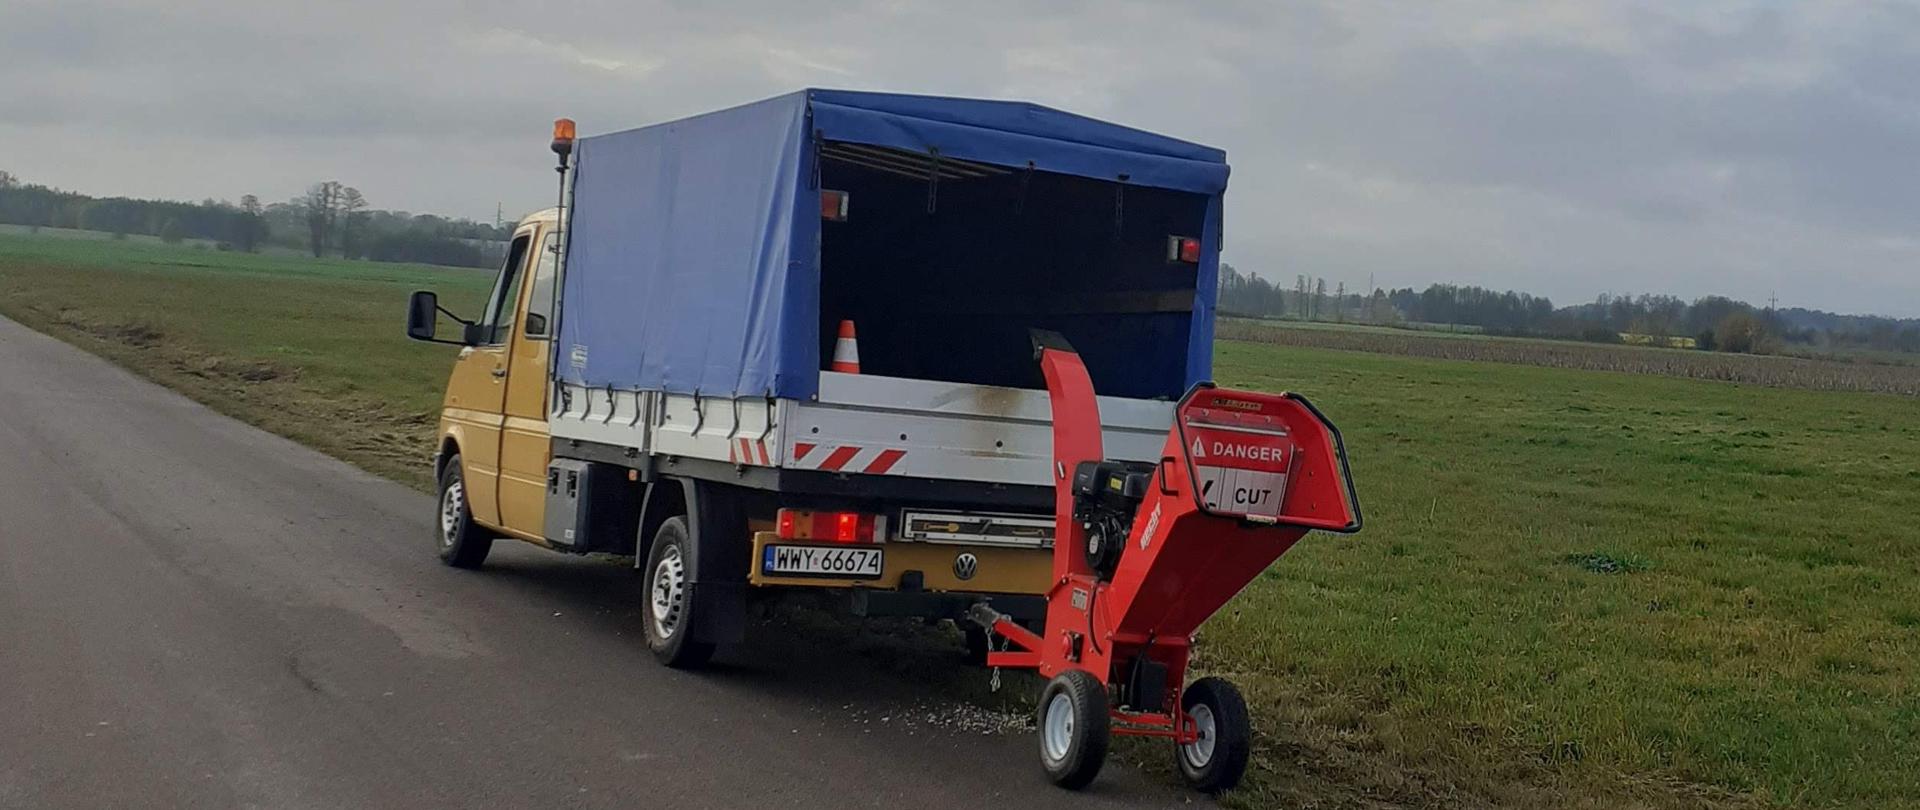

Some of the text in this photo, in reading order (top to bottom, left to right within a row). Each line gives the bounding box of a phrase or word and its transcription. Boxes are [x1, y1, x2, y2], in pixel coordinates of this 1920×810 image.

[1212, 441, 1283, 462] DANGER
[1235, 487, 1271, 505] CUT
[777, 548, 880, 573] WWY 66674
